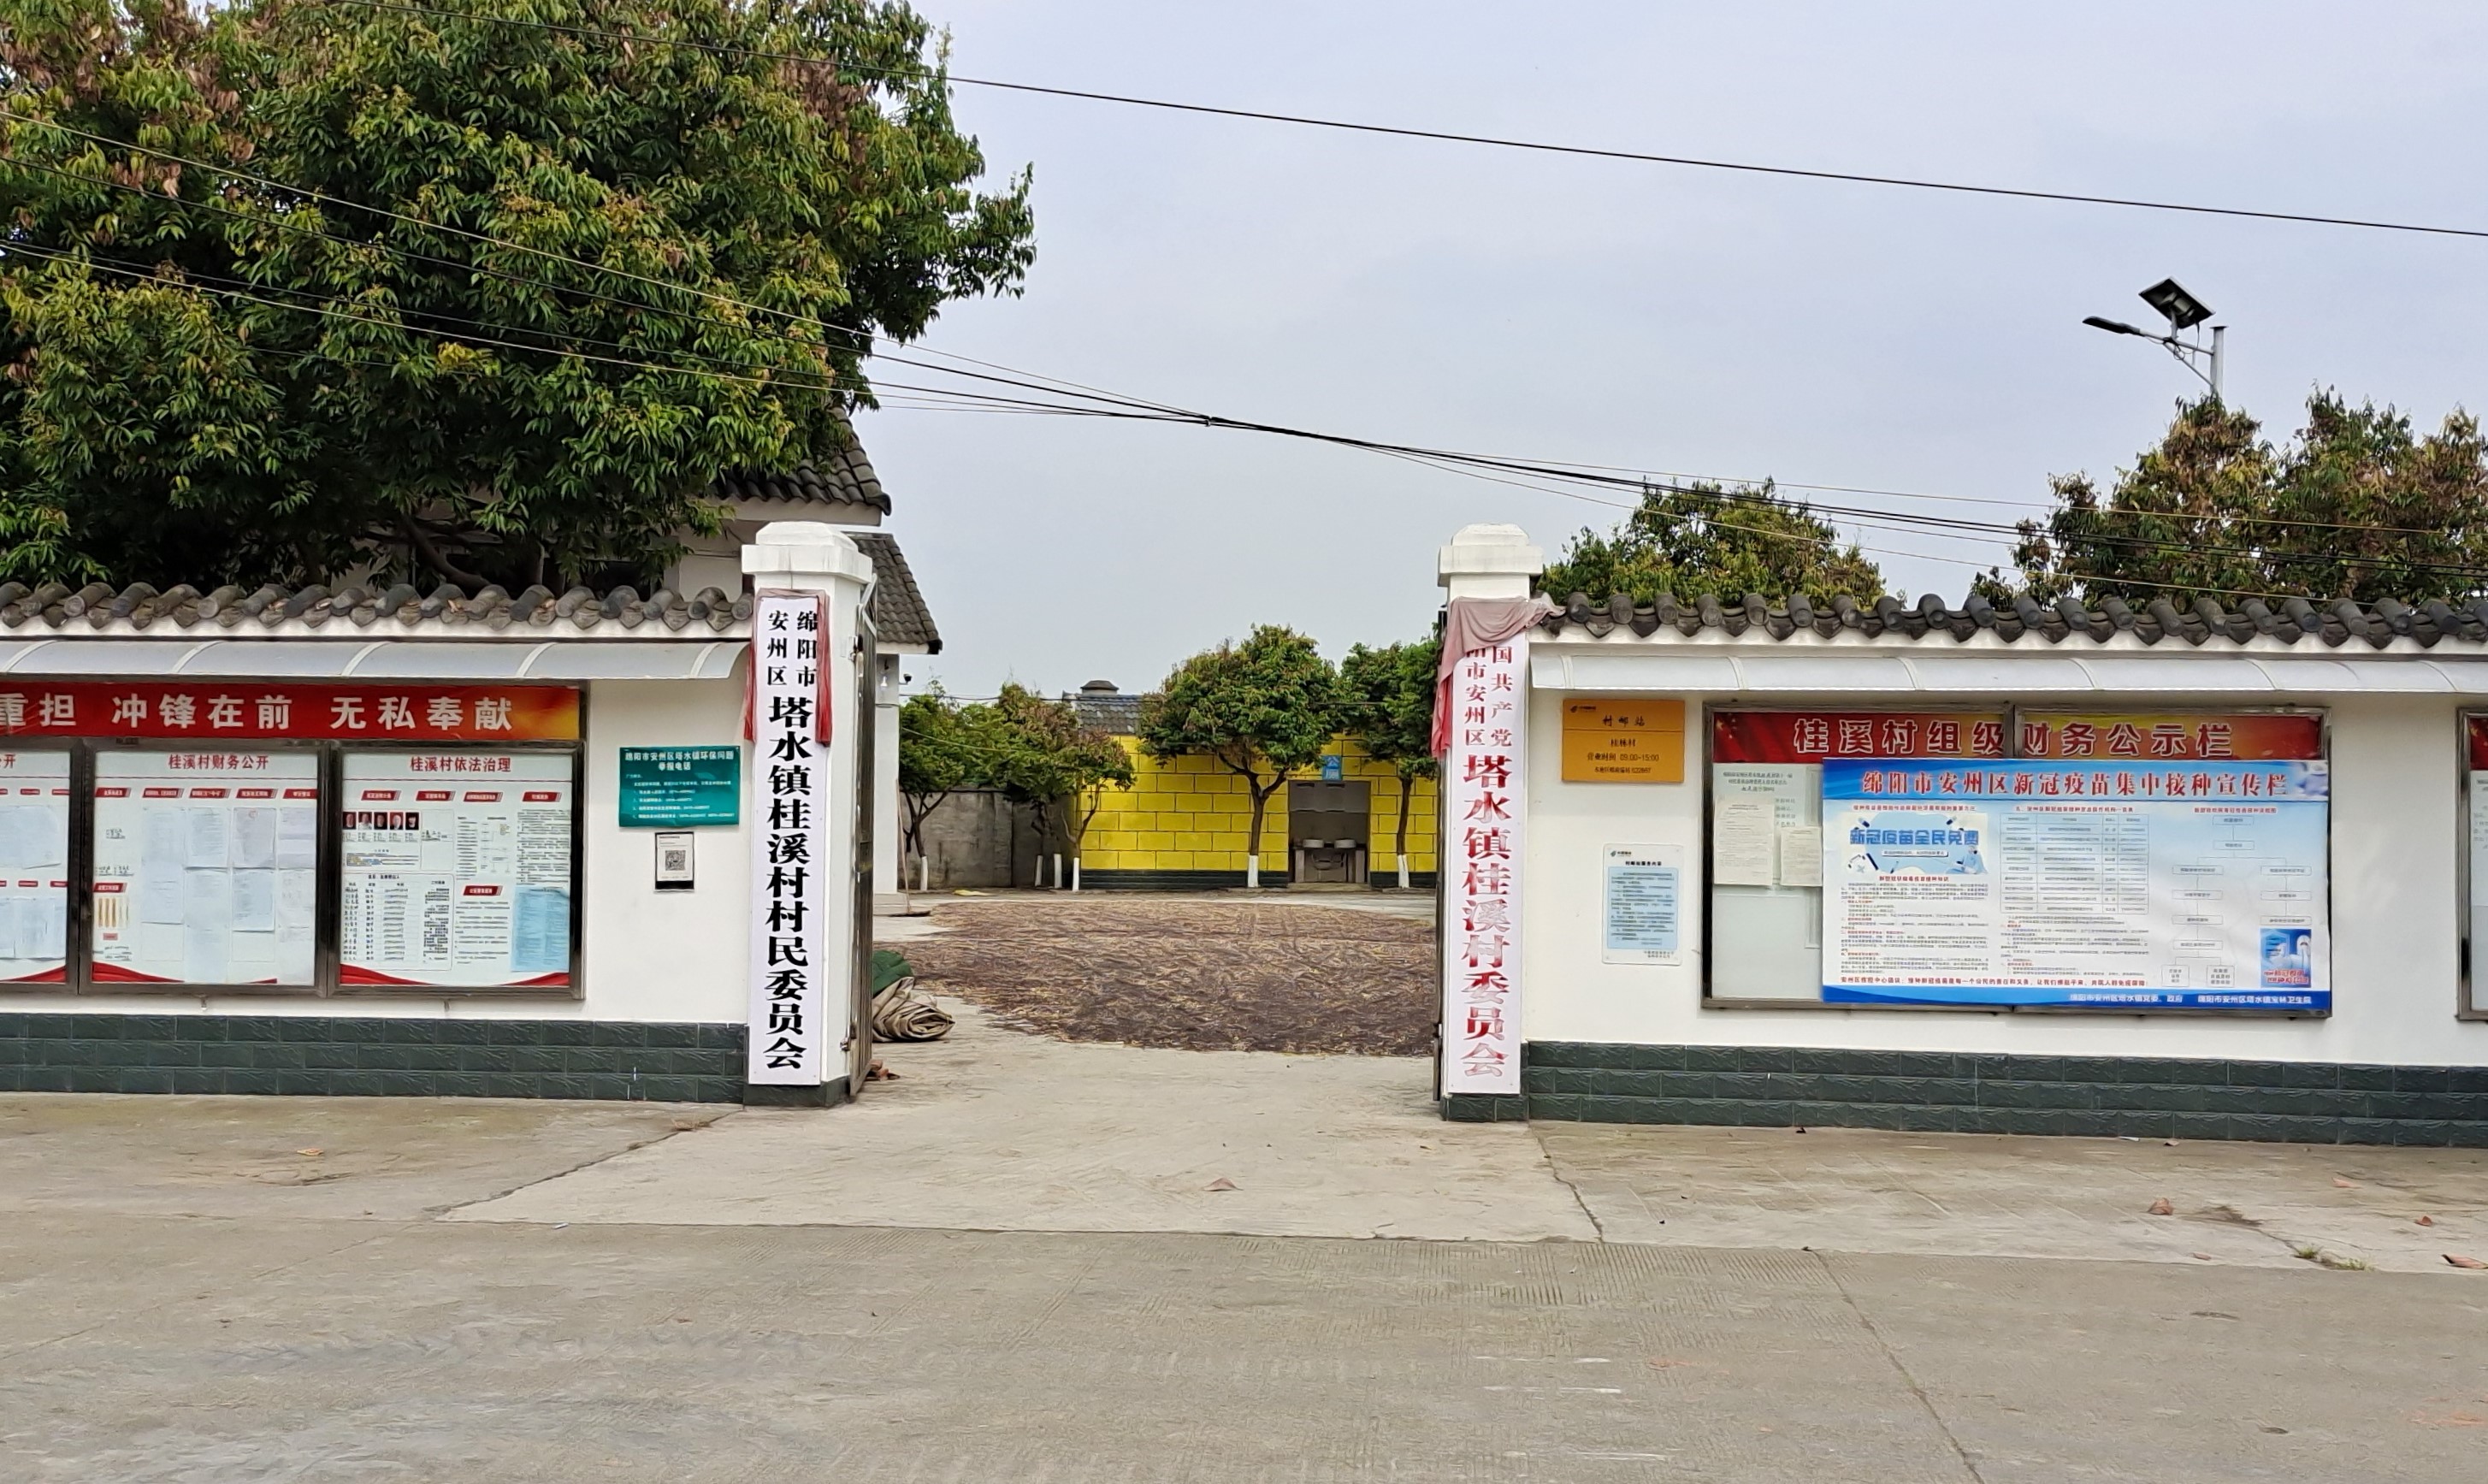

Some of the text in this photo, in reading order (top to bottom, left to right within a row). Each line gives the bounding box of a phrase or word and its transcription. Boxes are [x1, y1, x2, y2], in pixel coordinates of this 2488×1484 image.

[767, 610, 789, 687] 安州区
[796, 610, 818, 688] 绵阳市
[0, 693, 513, 731] 重担 冲锋在前 无私奉献
[1463, 647, 1487, 747] 市安州区
[1491, 645, 1513, 748] 国共产党
[625, 751, 735, 761] 绵阳市安州区塔水镇环保问题
[1794, 718, 2233, 758] 桂溪村组级财务公示栏
[168, 754, 269, 770] 桂溪村财务公开
[411, 756, 511, 772] 桂溪村依法治理
[659, 762, 692, 772] 举报电话
[1862, 770, 2290, 797] 绵阳市安州区新冠疫苗集中接种宣传栏
[1849, 829, 1980, 846] 新冠疫苗全民免费
[764, 695, 813, 1069] 塔水镇桂溪村村民委员会
[1461, 754, 1513, 1078] 塔水镇桂溪村委员会
